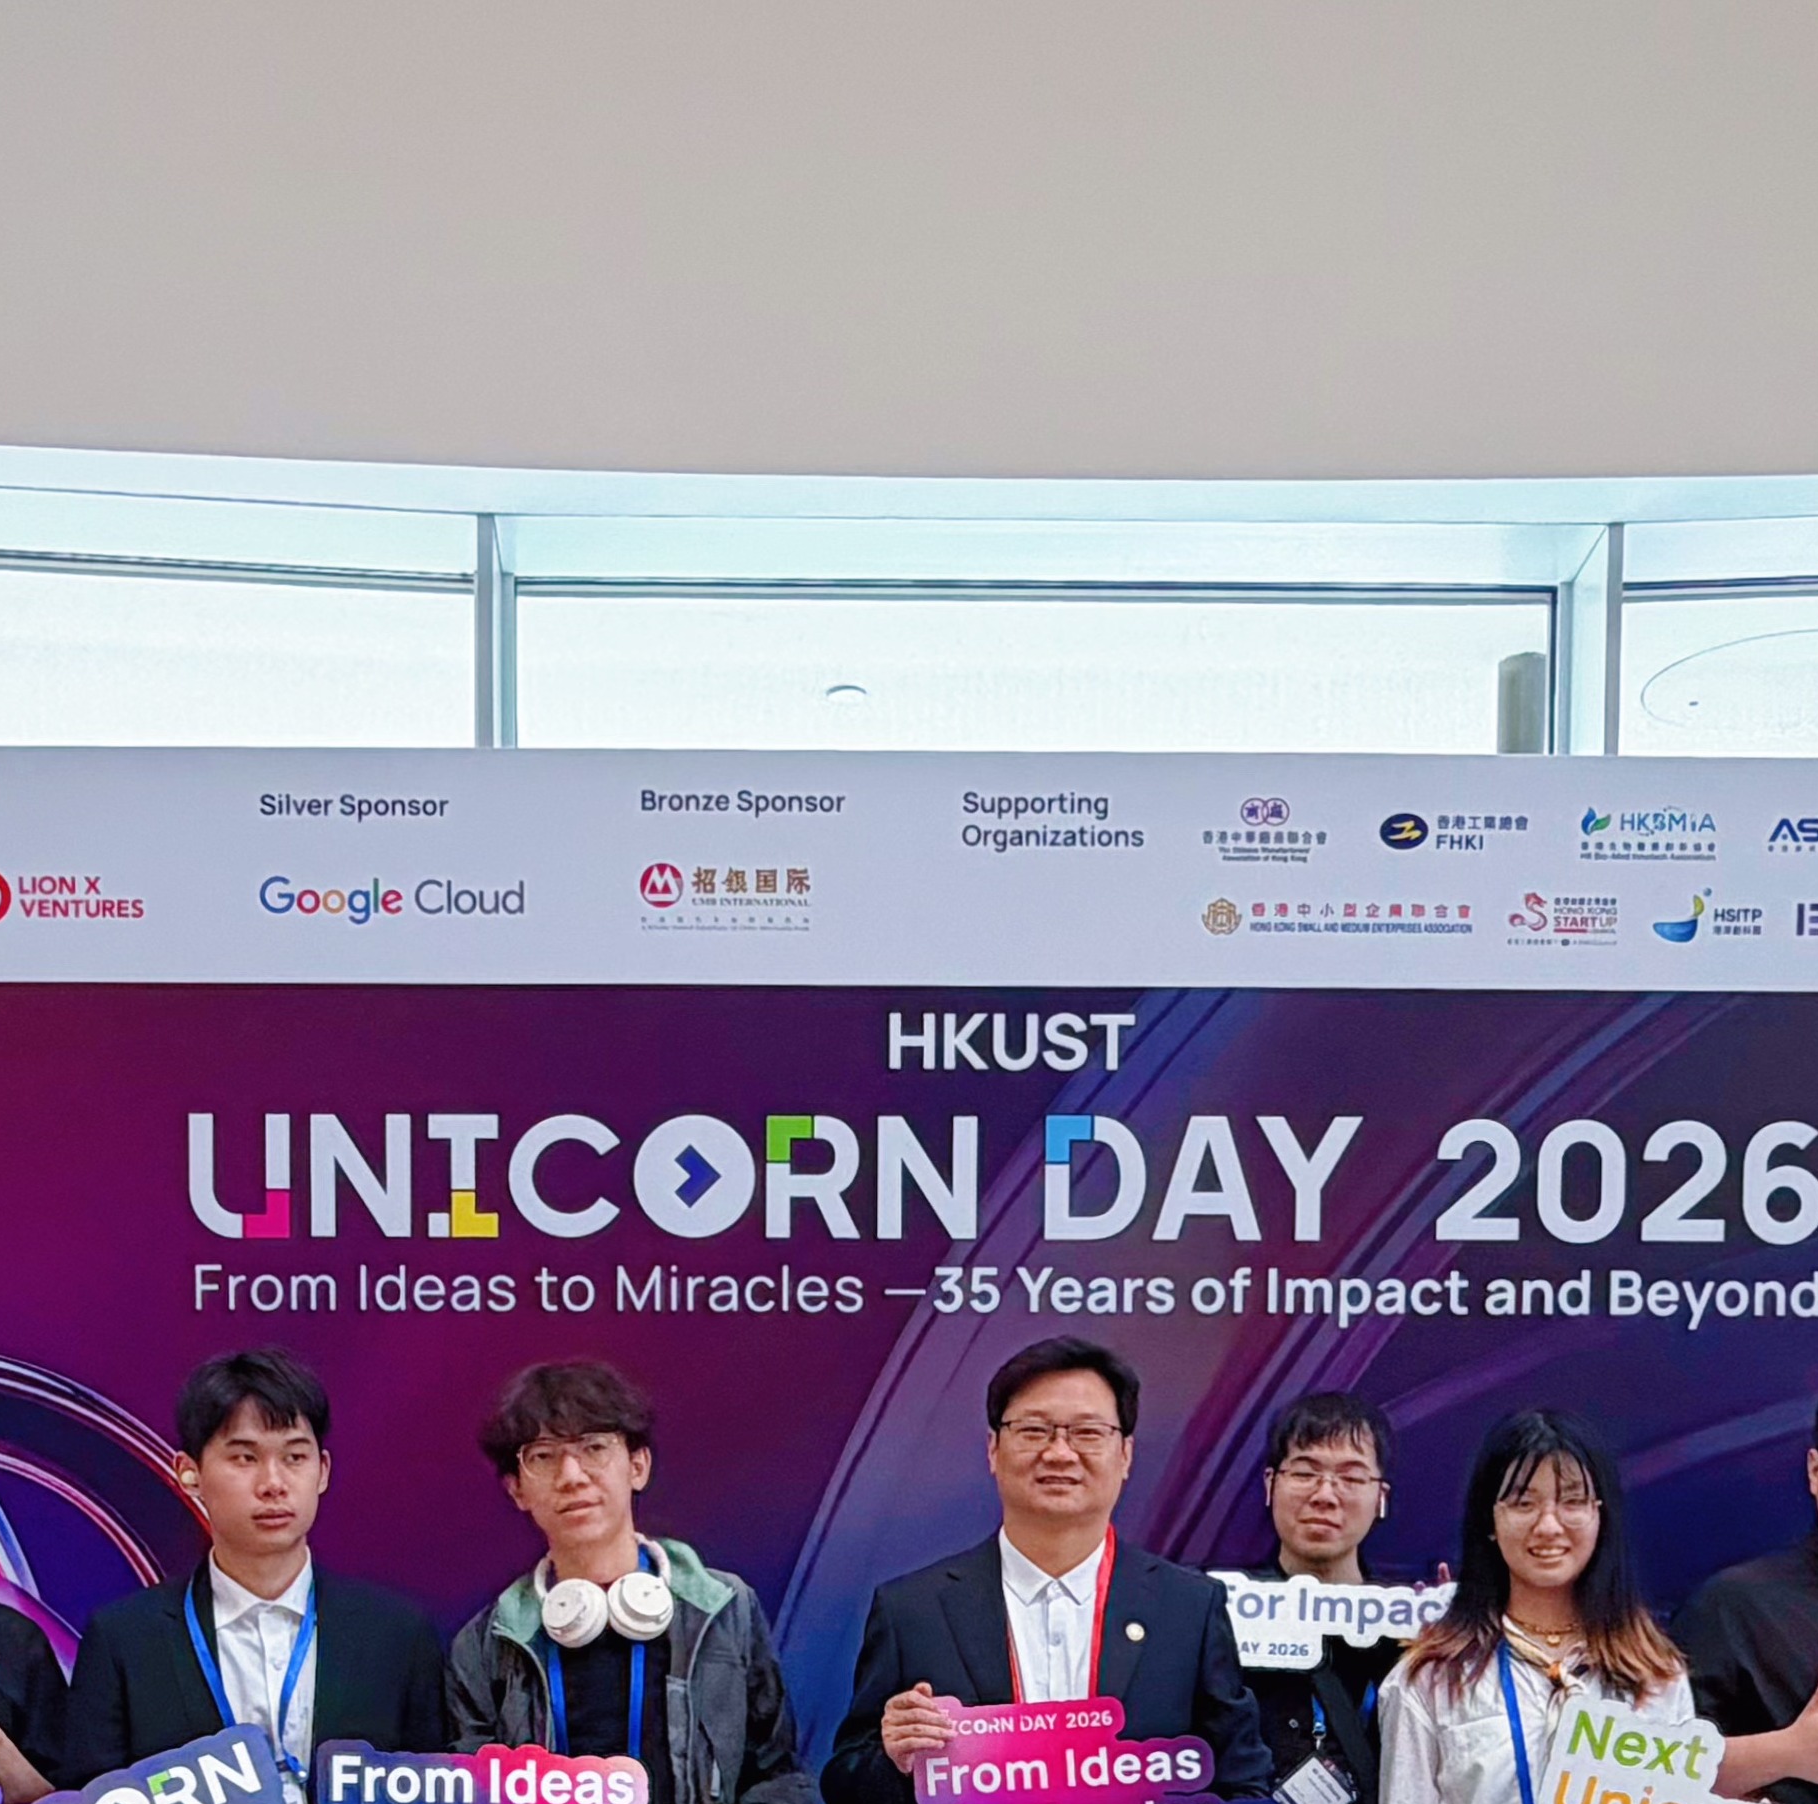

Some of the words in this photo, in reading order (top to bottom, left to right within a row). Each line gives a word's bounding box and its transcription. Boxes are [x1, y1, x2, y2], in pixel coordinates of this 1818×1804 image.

[259, 793, 333, 818] Silver
[339, 794, 450, 822] Sponsor
[640, 789, 731, 813] Bronze
[736, 790, 846, 817] Sponsor
[962, 791, 1109, 820] Supporting
[962, 824, 1145, 848] Organizations
[1436, 834, 1484, 850] FHKI
[19, 876, 79, 894] LION
[85, 876, 101, 894] X
[691, 866, 811, 896] 招银国际
[20, 900, 144, 919] VENTURES
[259, 875, 403, 925] Google
[414, 880, 526, 916] Cloud
[719, 897, 811, 908] INTERNATIONAL
[1251, 902, 1472, 919] 香港中小型企業聯合會
[1714, 908, 1763, 923] HSITP
[886, 1013, 1134, 1072] HKUST
[187, 1112, 980, 1241] UNICORN
[1045, 1117, 1363, 1241] DAY
[193, 1265, 339, 1315] From
[356, 1265, 518, 1315] Ideas
[535, 1268, 598, 1315] to
[613, 1265, 864, 1315] Miracles
[1015, 1265, 1175, 1315] Years
[1190, 1265, 1251, 1315] of
[1266, 1265, 1471, 1325] Impact
[1484, 1265, 1595, 1318] and
[1567, 1710, 1708, 1781] Next
[331, 1755, 473, 1804] From
[925, 1753, 1048, 1796] From
[1066, 1746, 1202, 1787] Ideas
